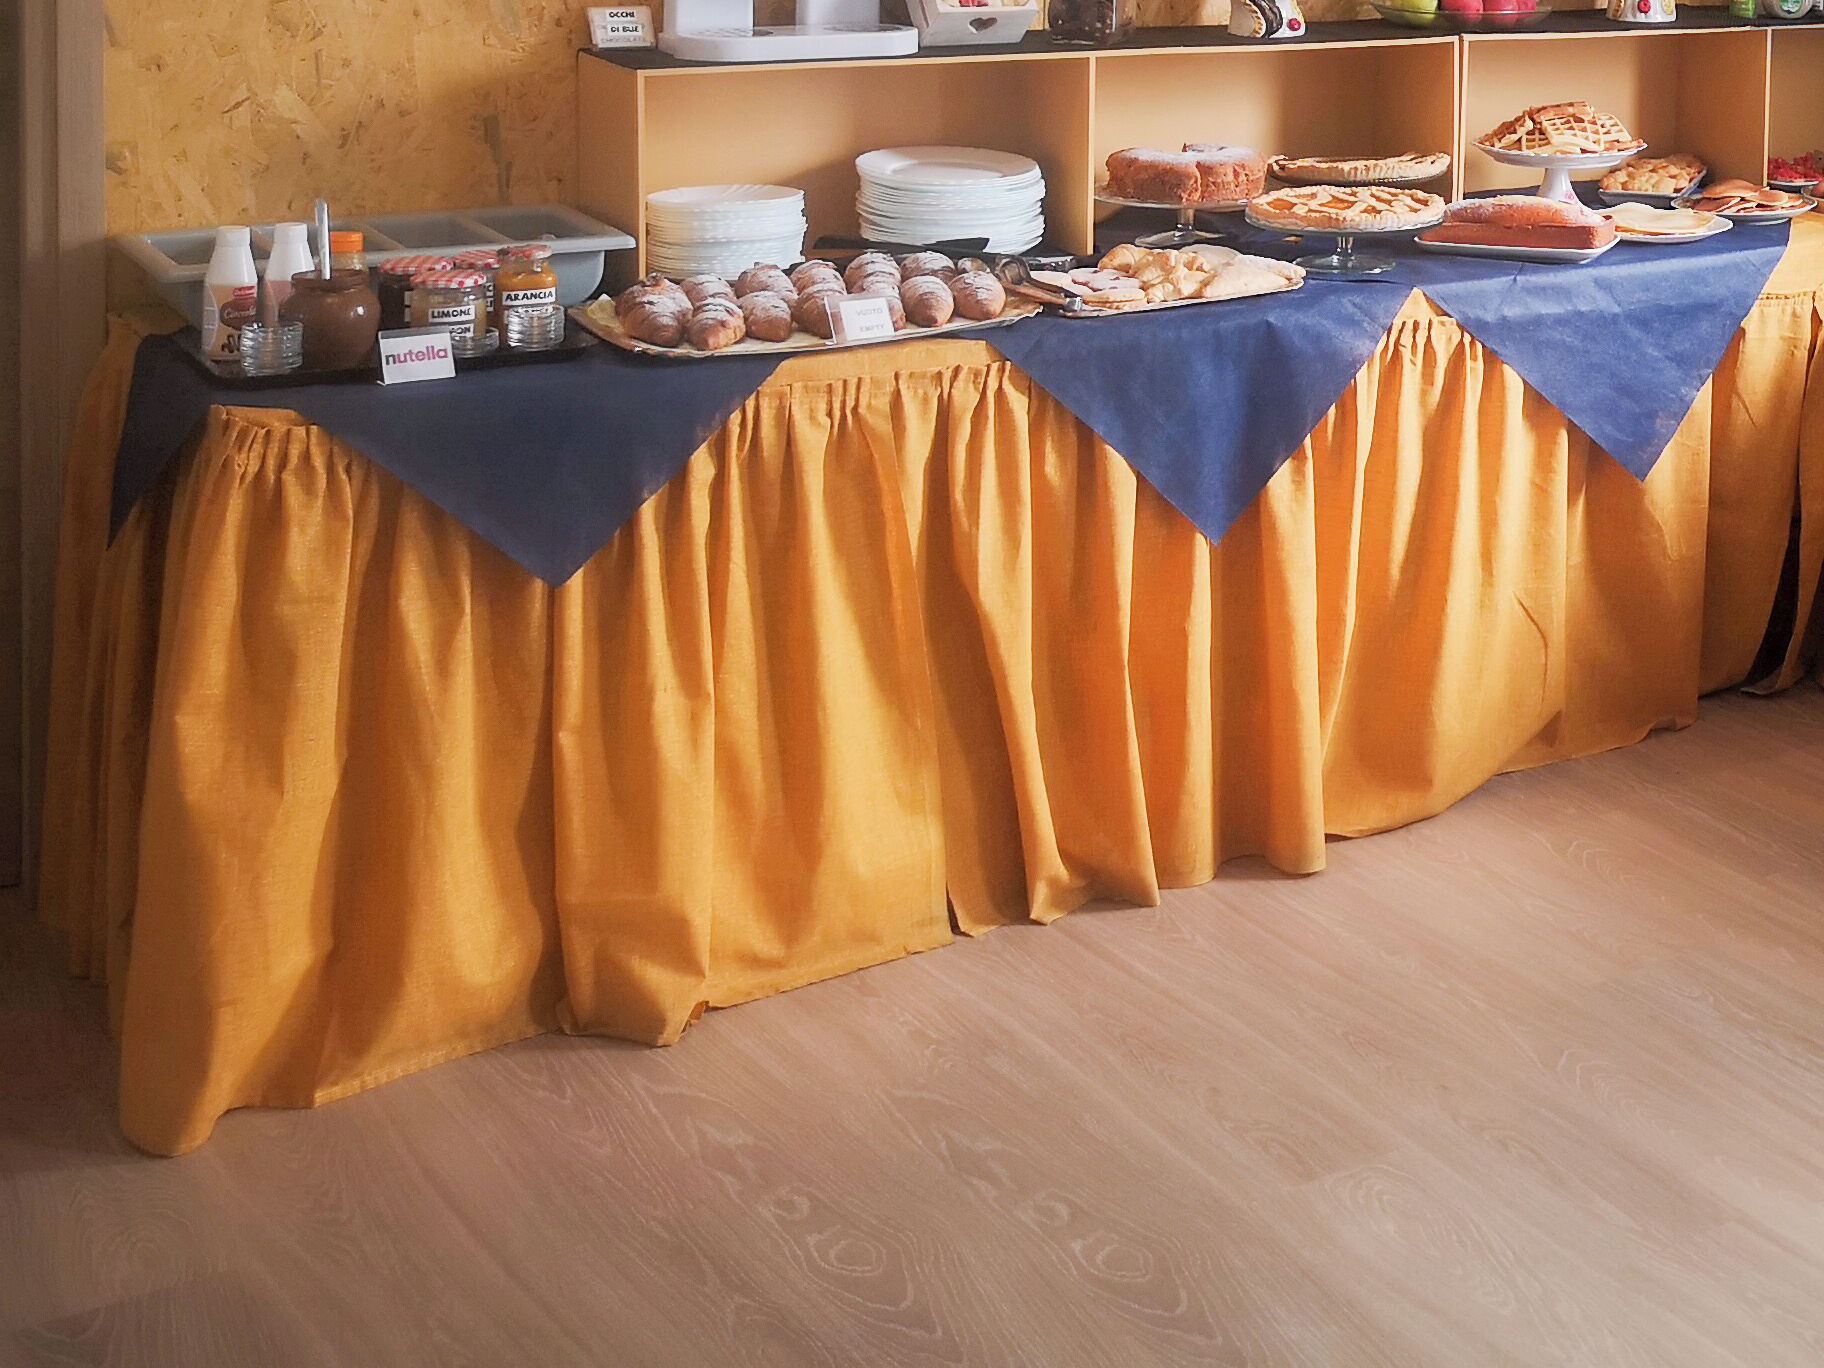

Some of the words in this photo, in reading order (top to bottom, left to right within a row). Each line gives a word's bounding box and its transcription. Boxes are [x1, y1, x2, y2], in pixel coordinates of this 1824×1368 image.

[608, 11, 635, 19] OCCHI
[504, 291, 554, 302] ARANCIA
[384, 345, 449, 367] nutella
